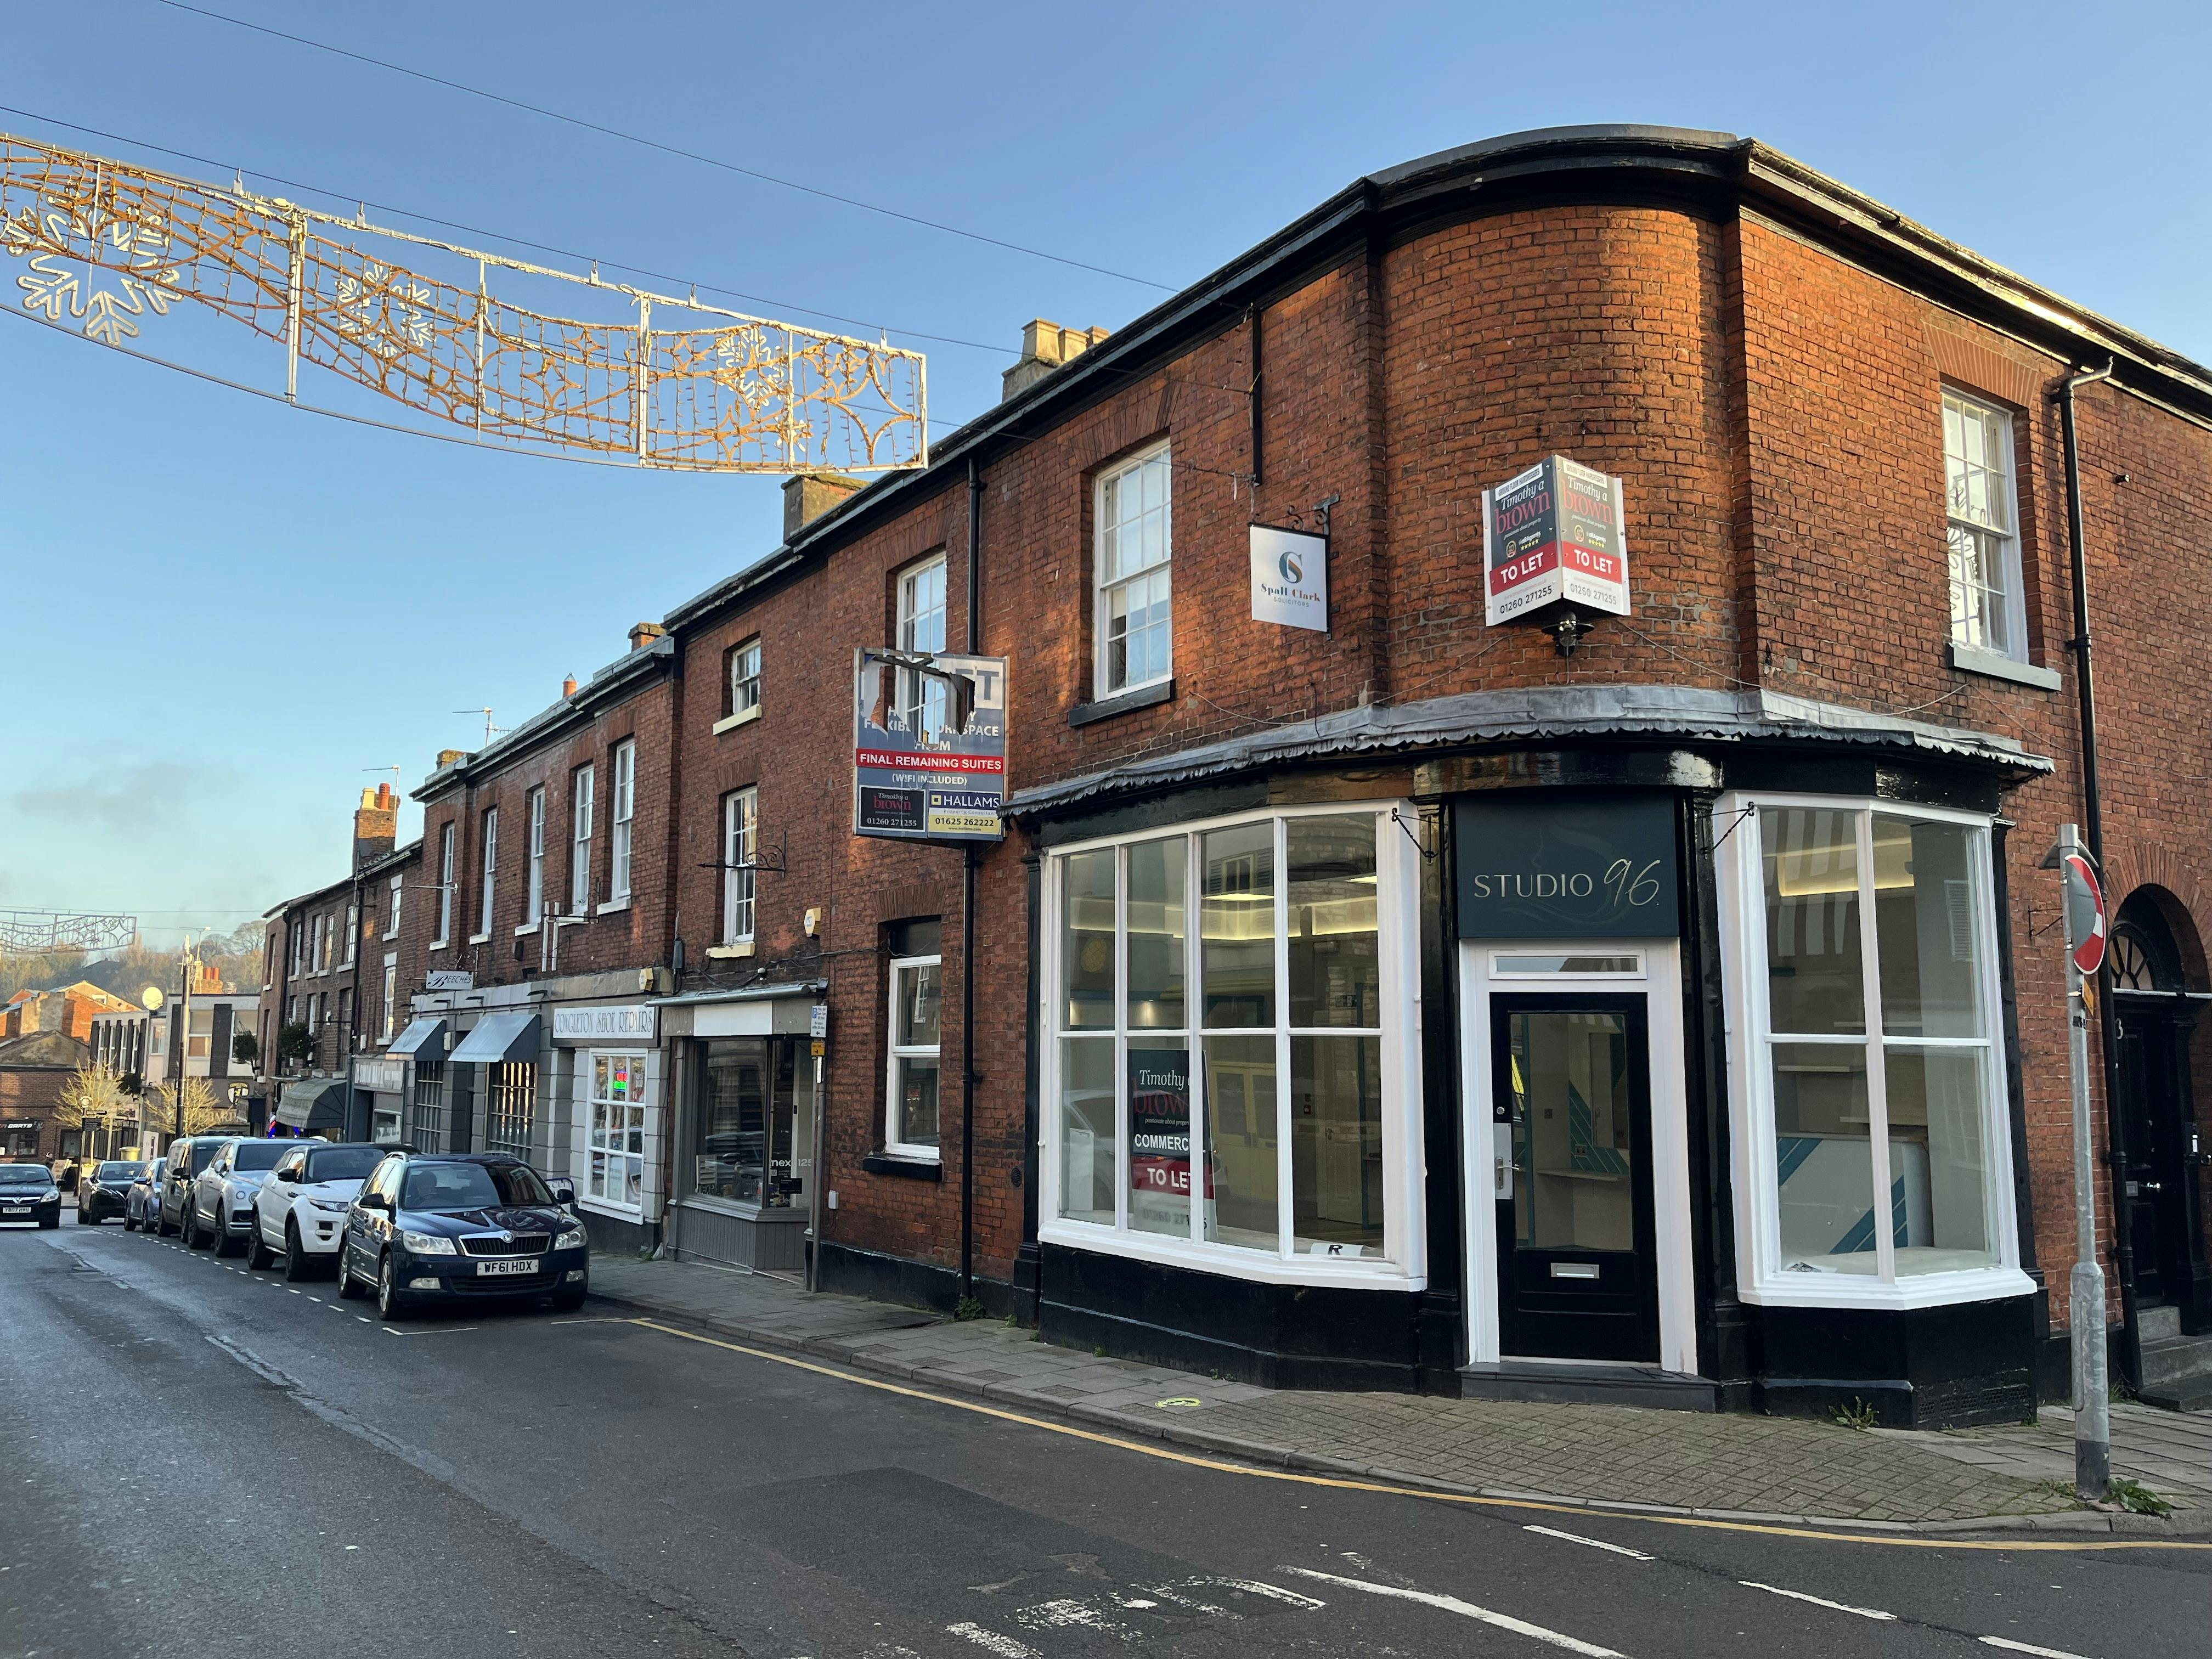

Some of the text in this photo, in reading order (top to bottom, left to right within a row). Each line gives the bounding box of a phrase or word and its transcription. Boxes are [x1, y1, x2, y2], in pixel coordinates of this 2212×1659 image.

[1501, 484, 1537, 511] Timothy
[1538, 481, 1544, 491] a
[1568, 476, 1607, 501] Timothy a
[1562, 479, 1613, 525] brown
[1494, 492, 1551, 535] brown
[1500, 552, 1544, 584] TO LET
[1574, 549, 1612, 574] TO LET
[1261, 583, 1321, 602] Spall Clark
[1273, 596, 1309, 607] SOLICITORS
[1500, 598, 1523, 614] 01260
[1525, 585, 1552, 605] 271255
[1570, 583, 1591, 597] 01260
[1593, 591, 1616, 605] 271255
[860, 753, 1002, 770] FINAL REMAINING SUITES
[892, 774, 916, 783] (WIFI
[873, 795, 912, 810] brown
[878, 793, 903, 801] Timothy
[944, 795, 999, 808] HALLAMS
[963, 819, 994, 827] 262222
[1474, 873, 1593, 898] STUDIO
[555, 1011, 652, 1032] CONGLETON SHOE REPAIRS
[1139, 1069, 1184, 1091] Timothy
[1132, 1077, 1189, 1115] brow
[1147, 1168, 1166, 1185] TO
[484, 1261, 532, 1273] WF61 HDX
